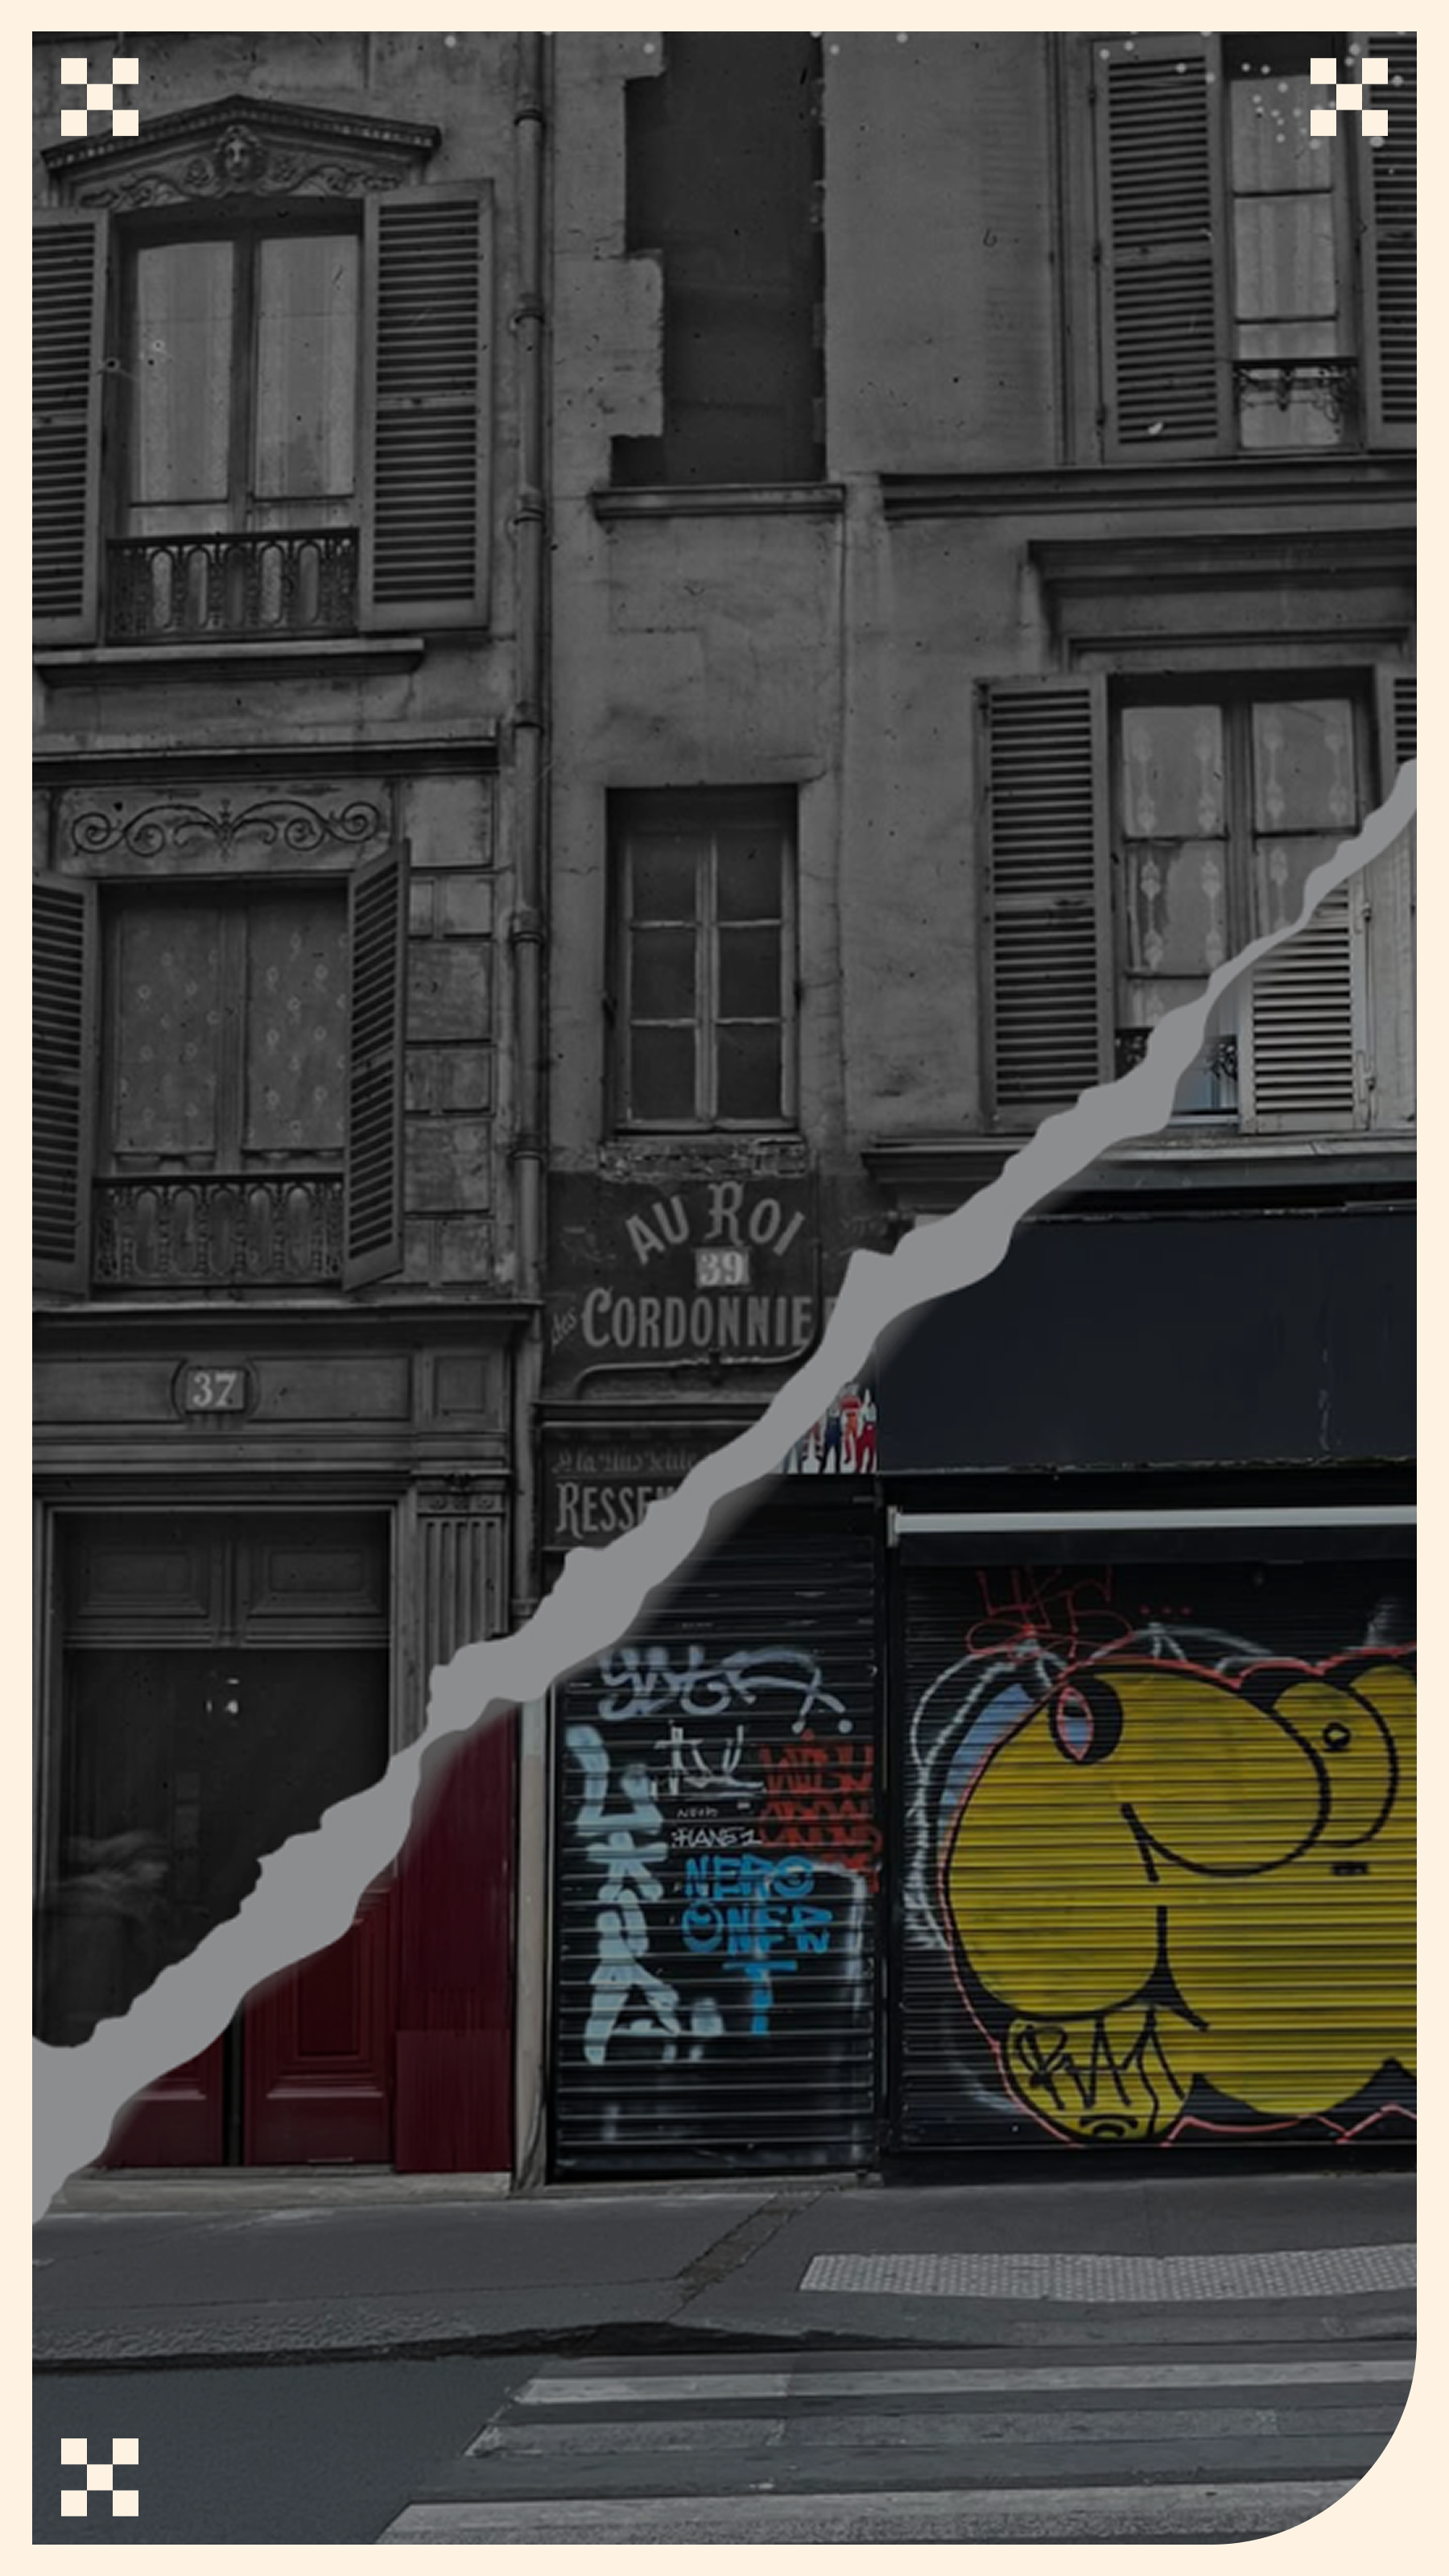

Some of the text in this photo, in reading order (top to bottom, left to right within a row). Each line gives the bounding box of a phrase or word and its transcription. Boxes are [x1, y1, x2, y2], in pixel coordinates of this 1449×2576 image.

[625, 1181, 805, 1265] AU ROI
[698, 1251, 747, 1286] 39
[192, 1371, 237, 1408] 37
